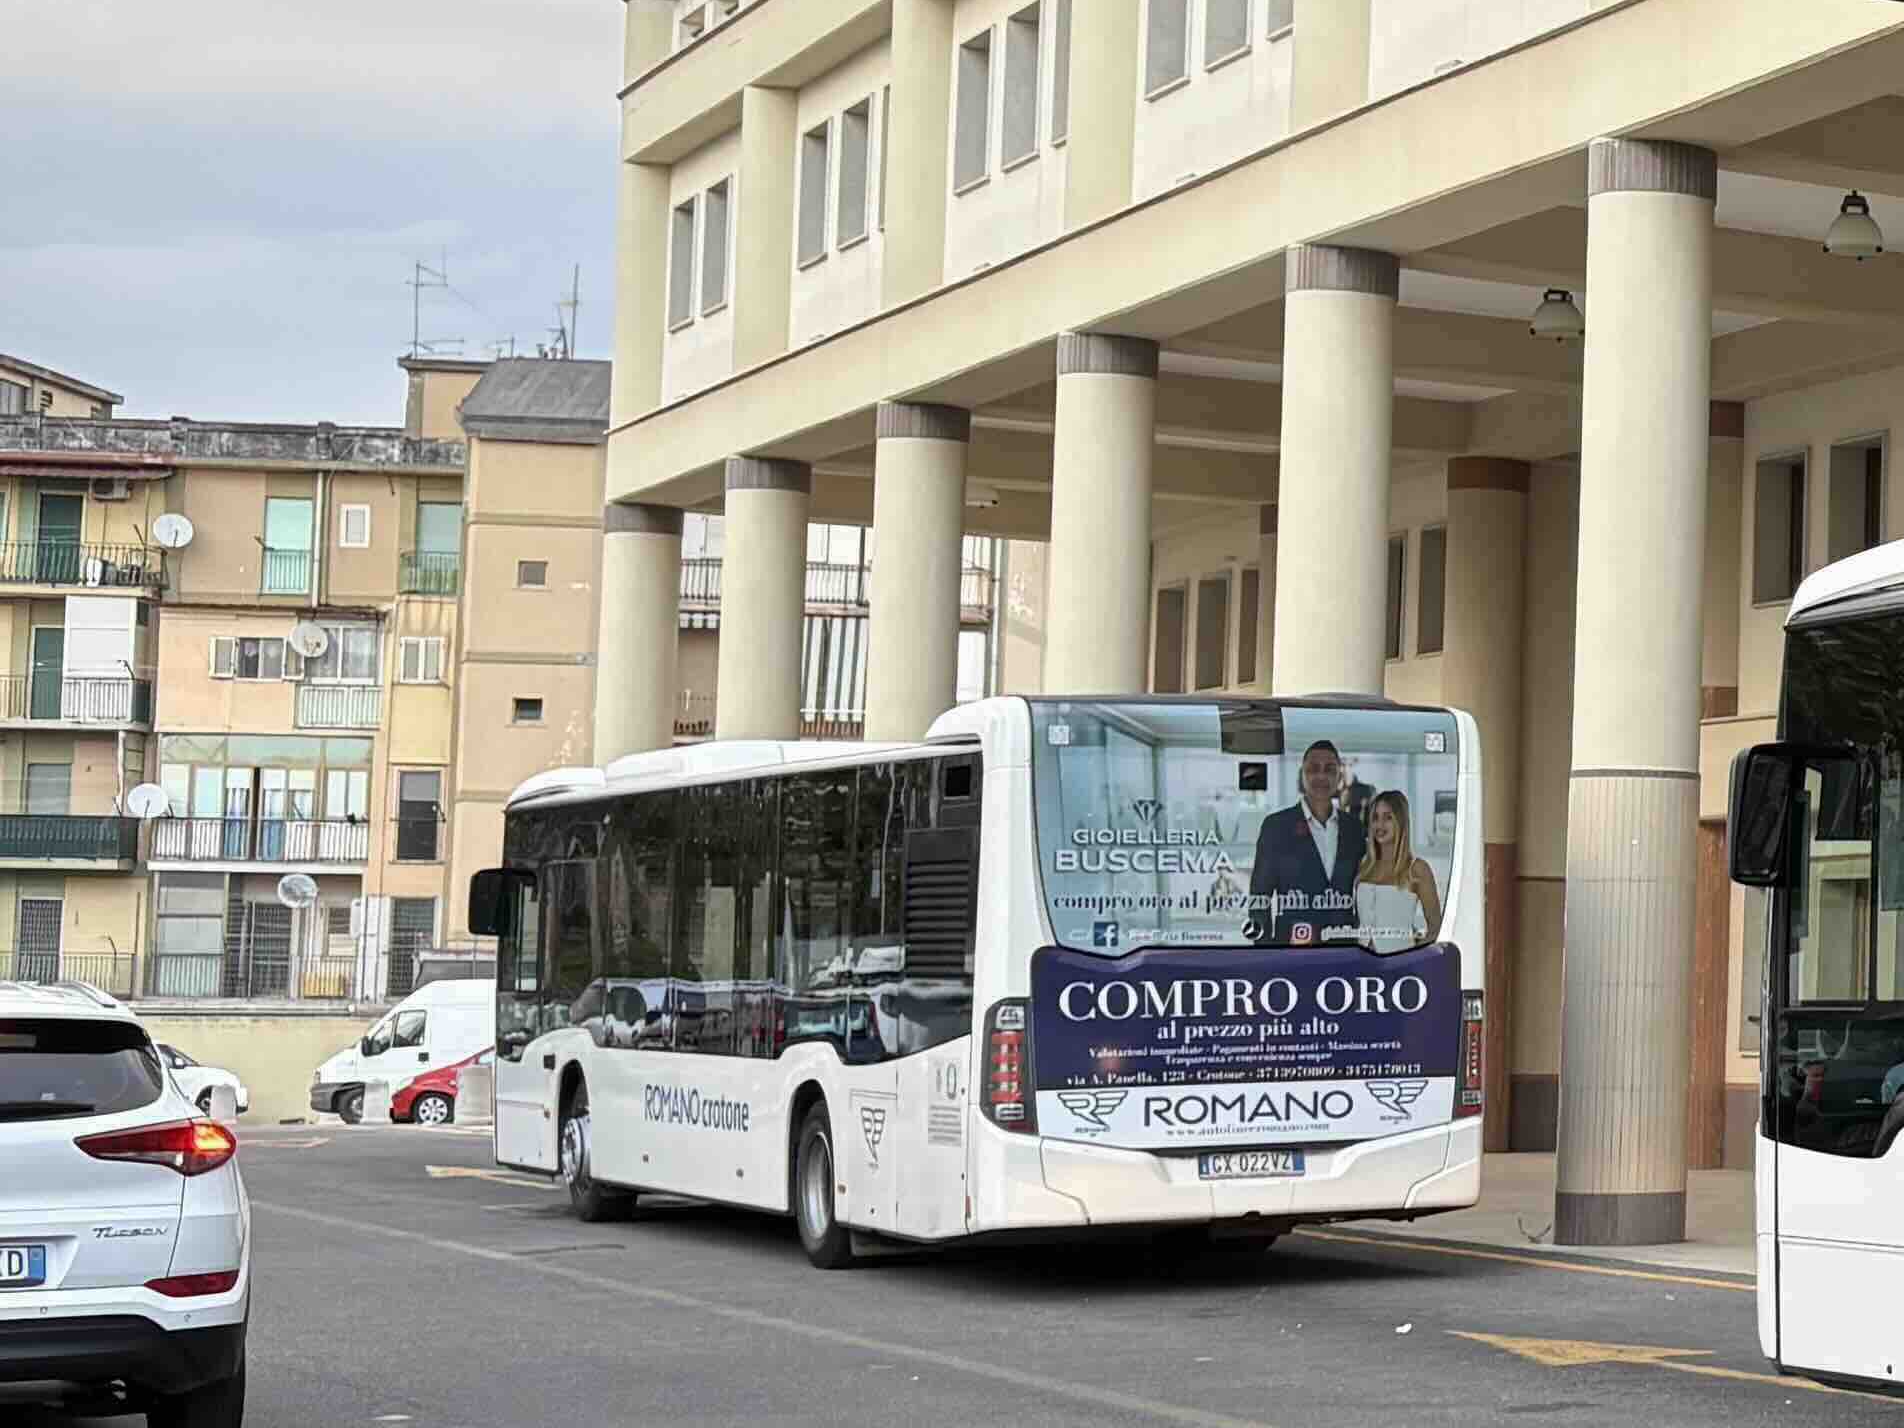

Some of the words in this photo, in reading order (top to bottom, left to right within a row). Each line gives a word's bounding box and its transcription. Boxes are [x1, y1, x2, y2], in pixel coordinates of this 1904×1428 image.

[1072, 828, 1221, 844] GIOIELLERIA
[1055, 849, 1235, 873] BUSCEMA
[1054, 893, 1133, 915] compro
[1179, 890, 1198, 908] al
[1058, 977, 1299, 1021] COMPRO
[1315, 975, 1428, 1015] ORO
[1156, 1020, 1176, 1040] al
[1184, 1023, 1253, 1044] prezzo
[1259, 1018, 1293, 1043] più
[1300, 1017, 1341, 1037] alto
[645, 1084, 700, 1125] ROMANO
[702, 1094, 749, 1132] crotone
[1144, 1090, 1354, 1127] ROMANO
